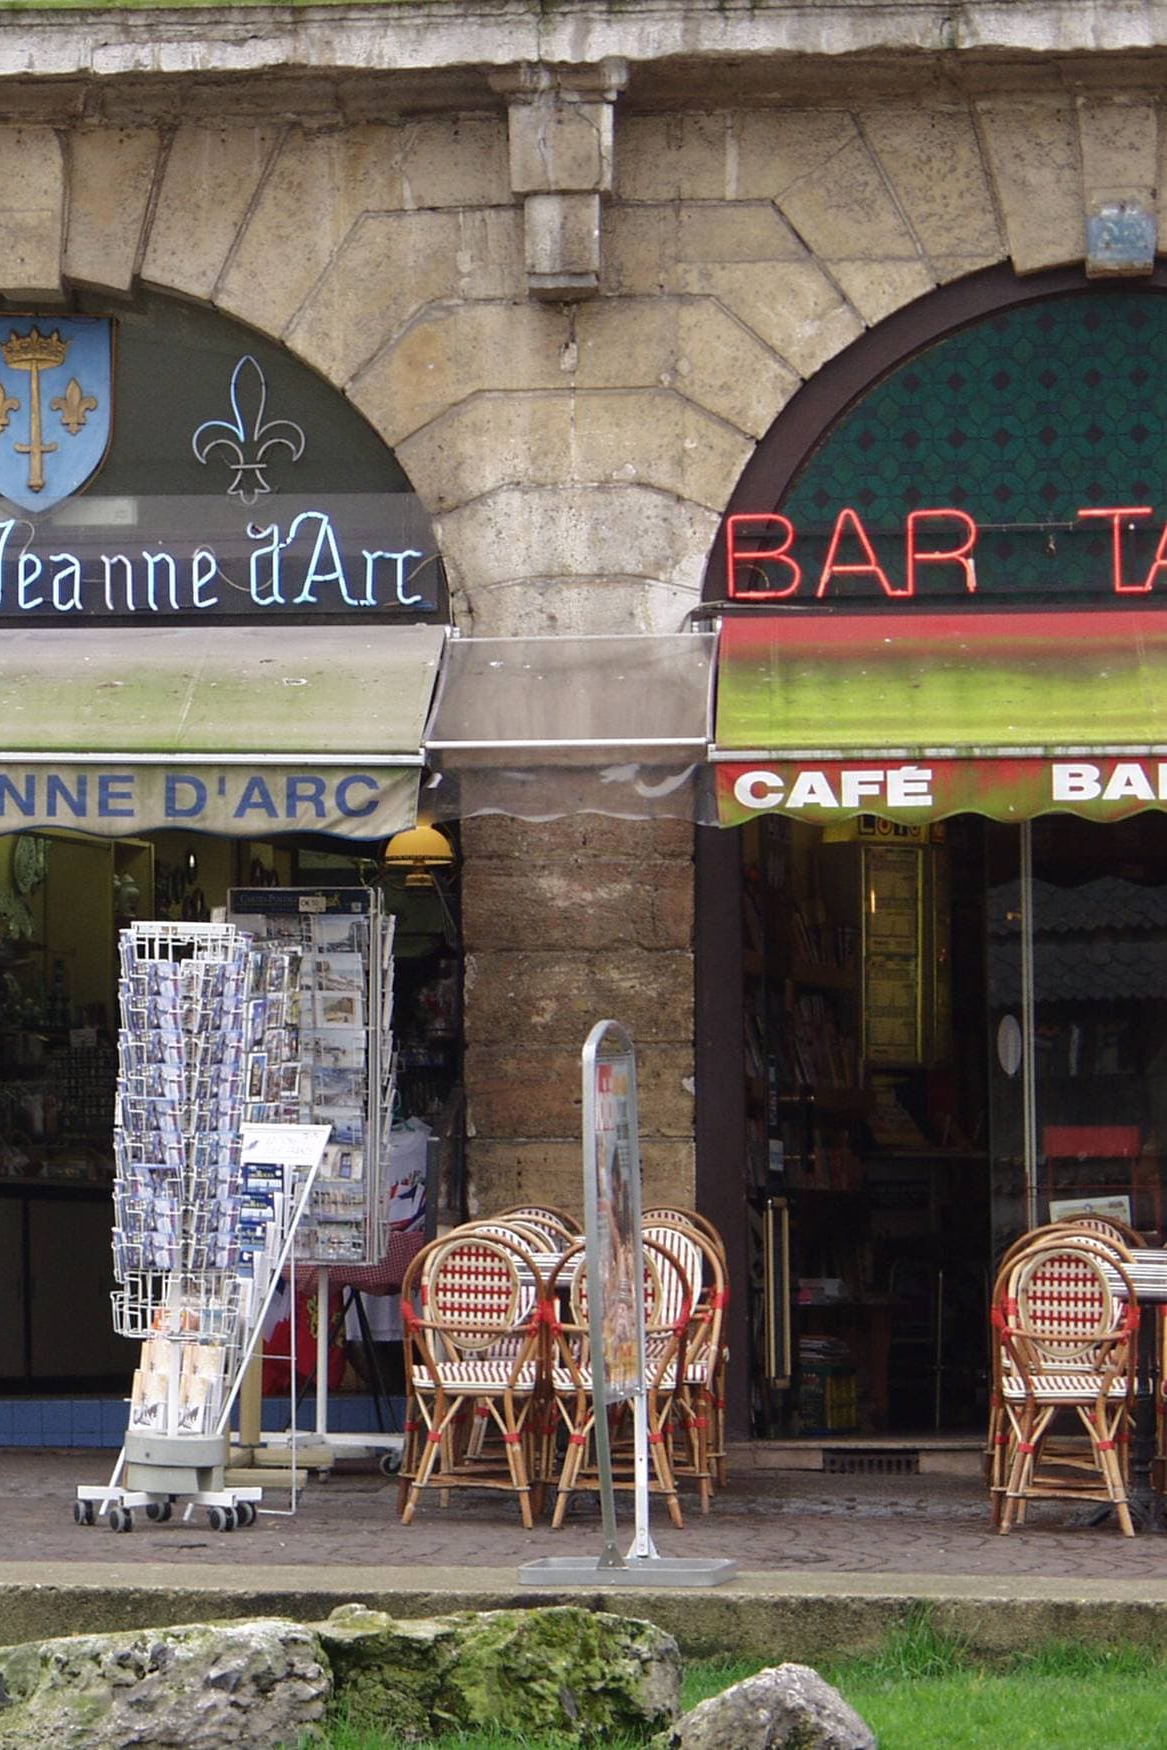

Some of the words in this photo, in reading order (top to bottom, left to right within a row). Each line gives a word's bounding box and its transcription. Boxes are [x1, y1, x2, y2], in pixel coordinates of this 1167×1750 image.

[245, 511, 423, 607] d'Arc
[726, 508, 978, 599] BAR
[1077, 506, 1167, 594] T
[164, 774, 381, 819] D'ARC
[734, 766, 933, 809] CAFÉ
[1052, 763, 1167, 801] BA
